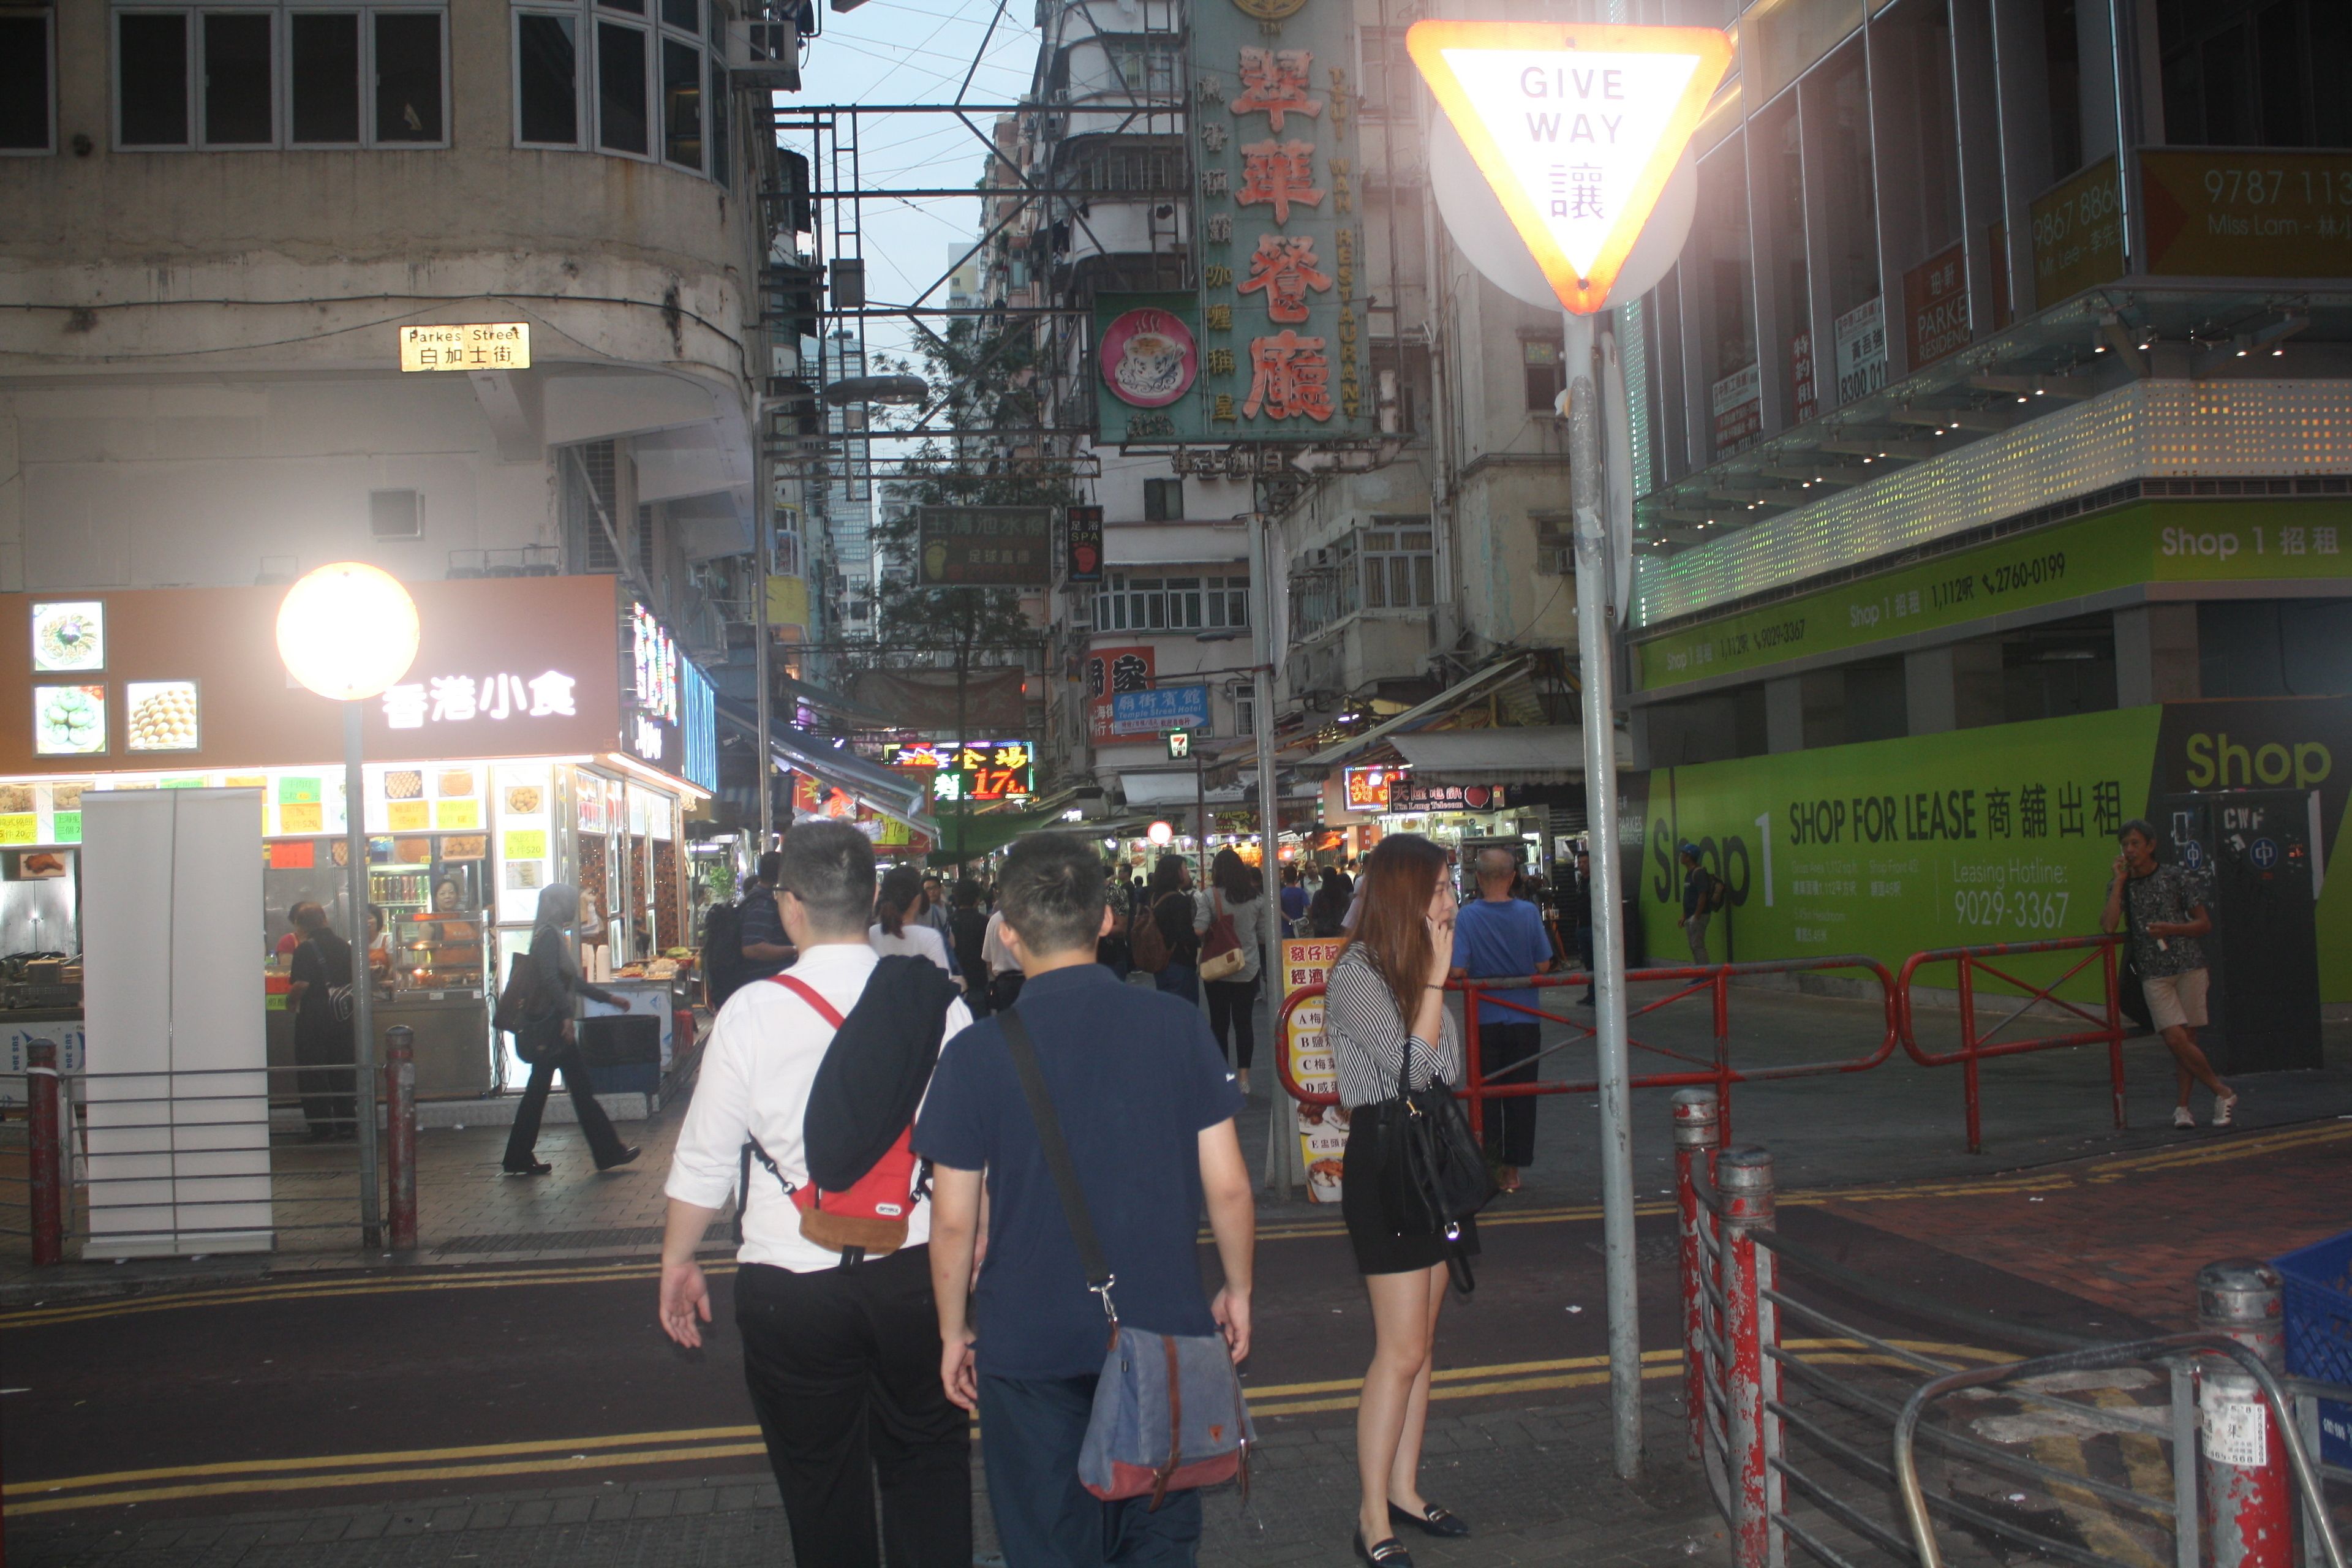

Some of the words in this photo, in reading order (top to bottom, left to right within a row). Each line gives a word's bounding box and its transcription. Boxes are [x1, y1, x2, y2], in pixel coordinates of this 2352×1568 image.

[1520, 66, 1624, 100] GIVE
[1526, 111, 1623, 144] WAY
[1329, 157, 1352, 214] WAH
[1548, 162, 1604, 220] 讓
[2205, 170, 2283, 205] 9787
[1230, 46, 1336, 423] 翠華餐廳
[2033, 200, 2073, 251] 9867
[2207, 214, 2249, 236] Miss
[2255, 214, 2298, 235] Lam
[2059, 247, 2079, 270] Lee
[1336, 228, 1360, 420] RESTAURANT
[1918, 294, 1967, 342] PARKE
[410, 330, 461, 343] Parkes
[473, 329, 520, 341] Street
[1920, 323, 1970, 363] RESIDENC
[420, 345, 511, 364] 白加士街
[1841, 368, 1866, 404] 8300
[1072, 532, 1098, 541] SPA
[2162, 527, 2239, 561] Shop
[2252, 527, 2263, 554] 1
[2280, 526, 2339, 555] 招租
[1996, 552, 2065, 594] 2760-0199
[1850, 603, 1879, 628] Shop
[1883, 596, 1890, 619] 1
[1895, 590, 1921, 618] 招租
[1762, 618, 1805, 648] 9029-3367
[1667, 652, 1687, 671] Shop
[382, 670, 576, 729] 香港小食
[1118, 710, 1148, 719] Temple
[1151, 707, 1175, 716] Street
[1178, 704, 1201, 713] Hotel
[2186, 733, 2332, 789] Shop
[1431, 801, 1463, 810] Telecom
[1790, 799, 1845, 846] SHOP
[1852, 795, 1899, 843] FOR
[1905, 789, 1977, 841] LEASE
[1755, 812, 1774, 907] 1
[1953, 859, 2005, 889] Leasing
[2010, 858, 2068, 884] Hotline:
[1955, 891, 2070, 929] 9029-3367
[1292, 968, 1332, 985] 經濟
[1299, 1014, 1307, 1025] A
[1301, 1037, 1310, 1047] B
[1303, 1060, 1312, 1071] C
[1311, 1140, 1319, 1149] E
